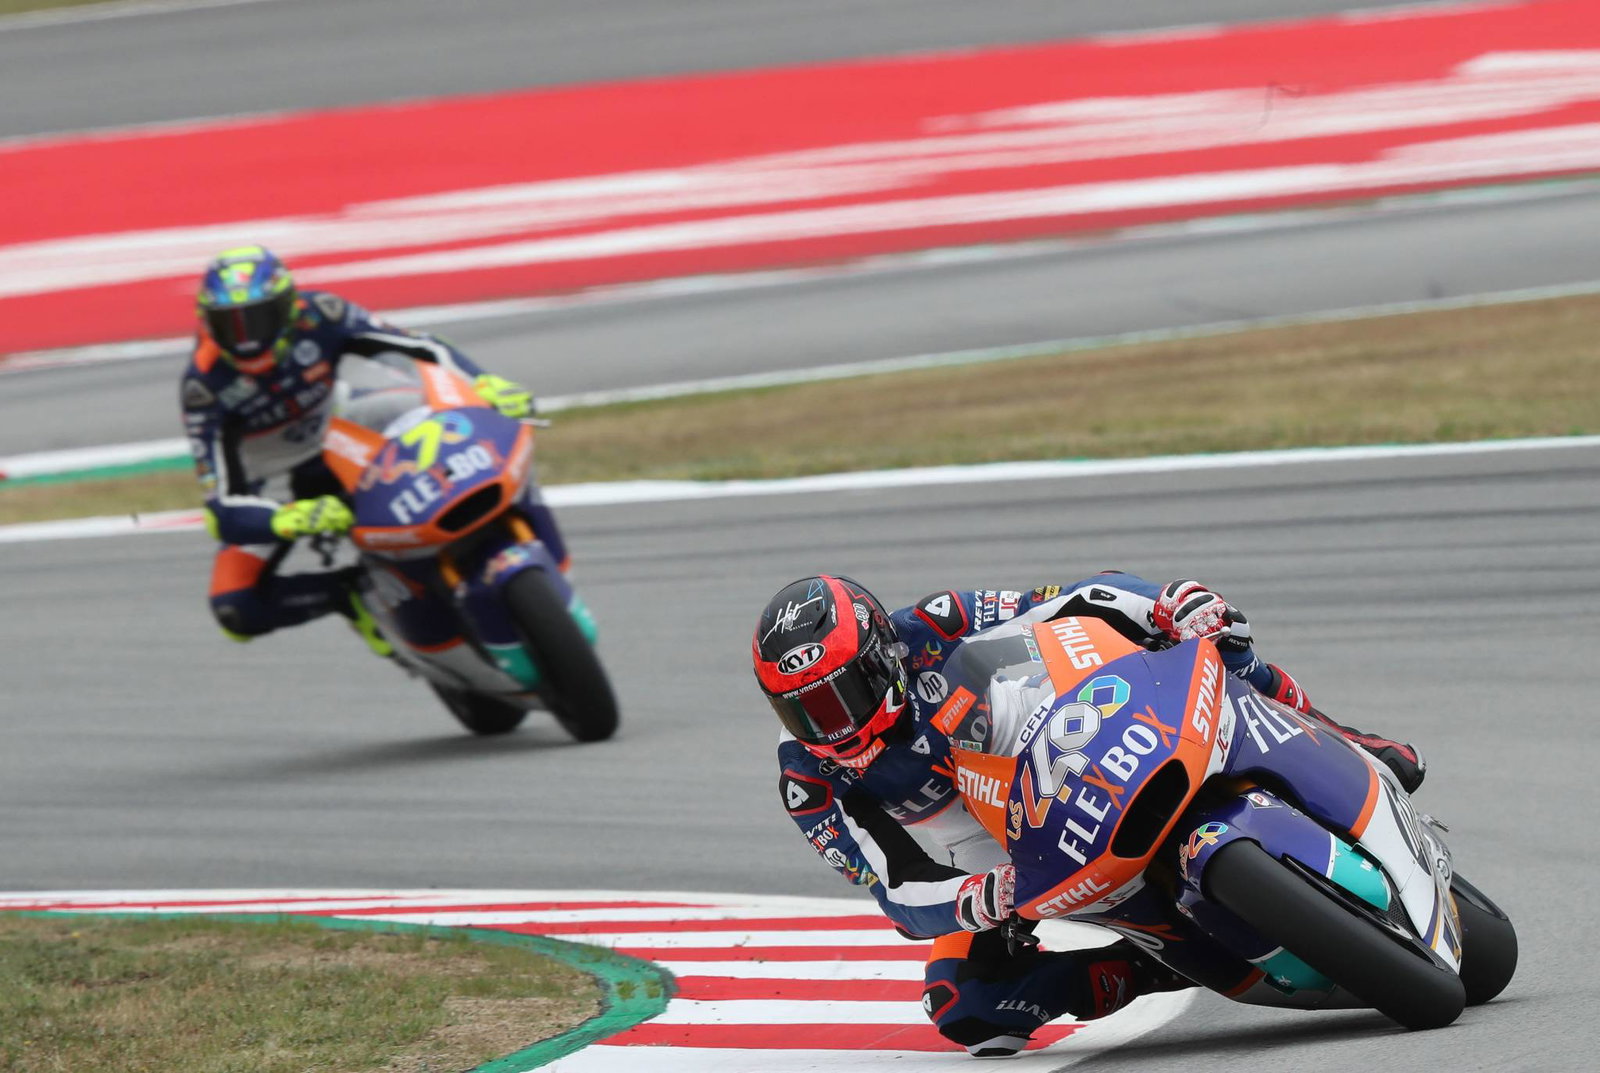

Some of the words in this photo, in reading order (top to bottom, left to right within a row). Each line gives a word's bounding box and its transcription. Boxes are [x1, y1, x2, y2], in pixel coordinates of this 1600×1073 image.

[778, 645, 820, 673] KYT
[1050, 616, 1103, 669] STIHL
[782, 666, 847, 700] WWW.VROOM.MEDIA
[917, 673, 944, 701] hp
[1192, 657, 1219, 743] STIHL
[942, 695, 969, 728] STIHL
[1020, 705, 1049, 743] CFH
[957, 765, 1005, 809] STIHL
[1058, 705, 1176, 866] FLEXBOX
[1035, 876, 1111, 917] STIHL
